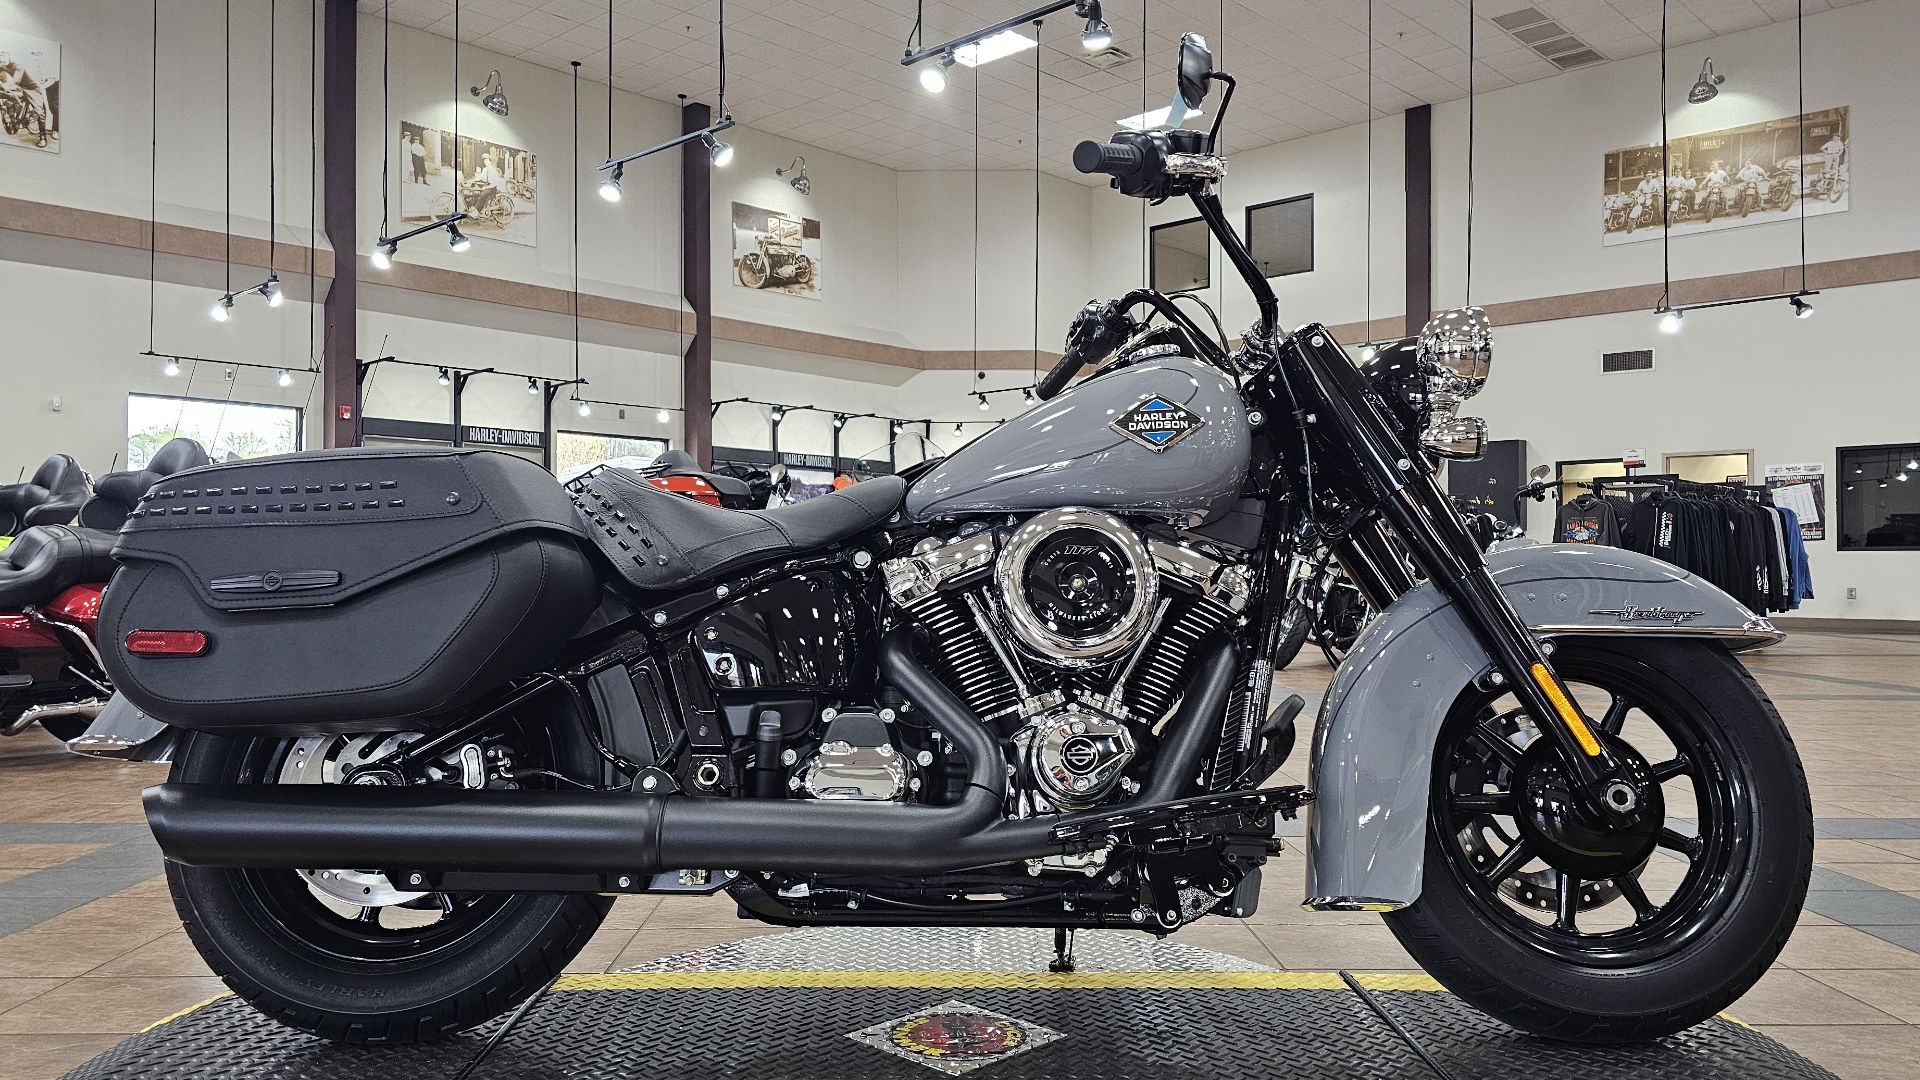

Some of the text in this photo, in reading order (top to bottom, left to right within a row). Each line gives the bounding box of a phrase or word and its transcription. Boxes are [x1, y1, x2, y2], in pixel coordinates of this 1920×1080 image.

[1133, 411, 1181, 422] HARLEY
[1128, 420, 1189, 431] DAVIDSON
[469, 427, 540, 446] HARLEY-DAVIDSON
[783, 453, 832, 468] HARLEY-DAVIDSON
[1064, 544, 1099, 555] 117
